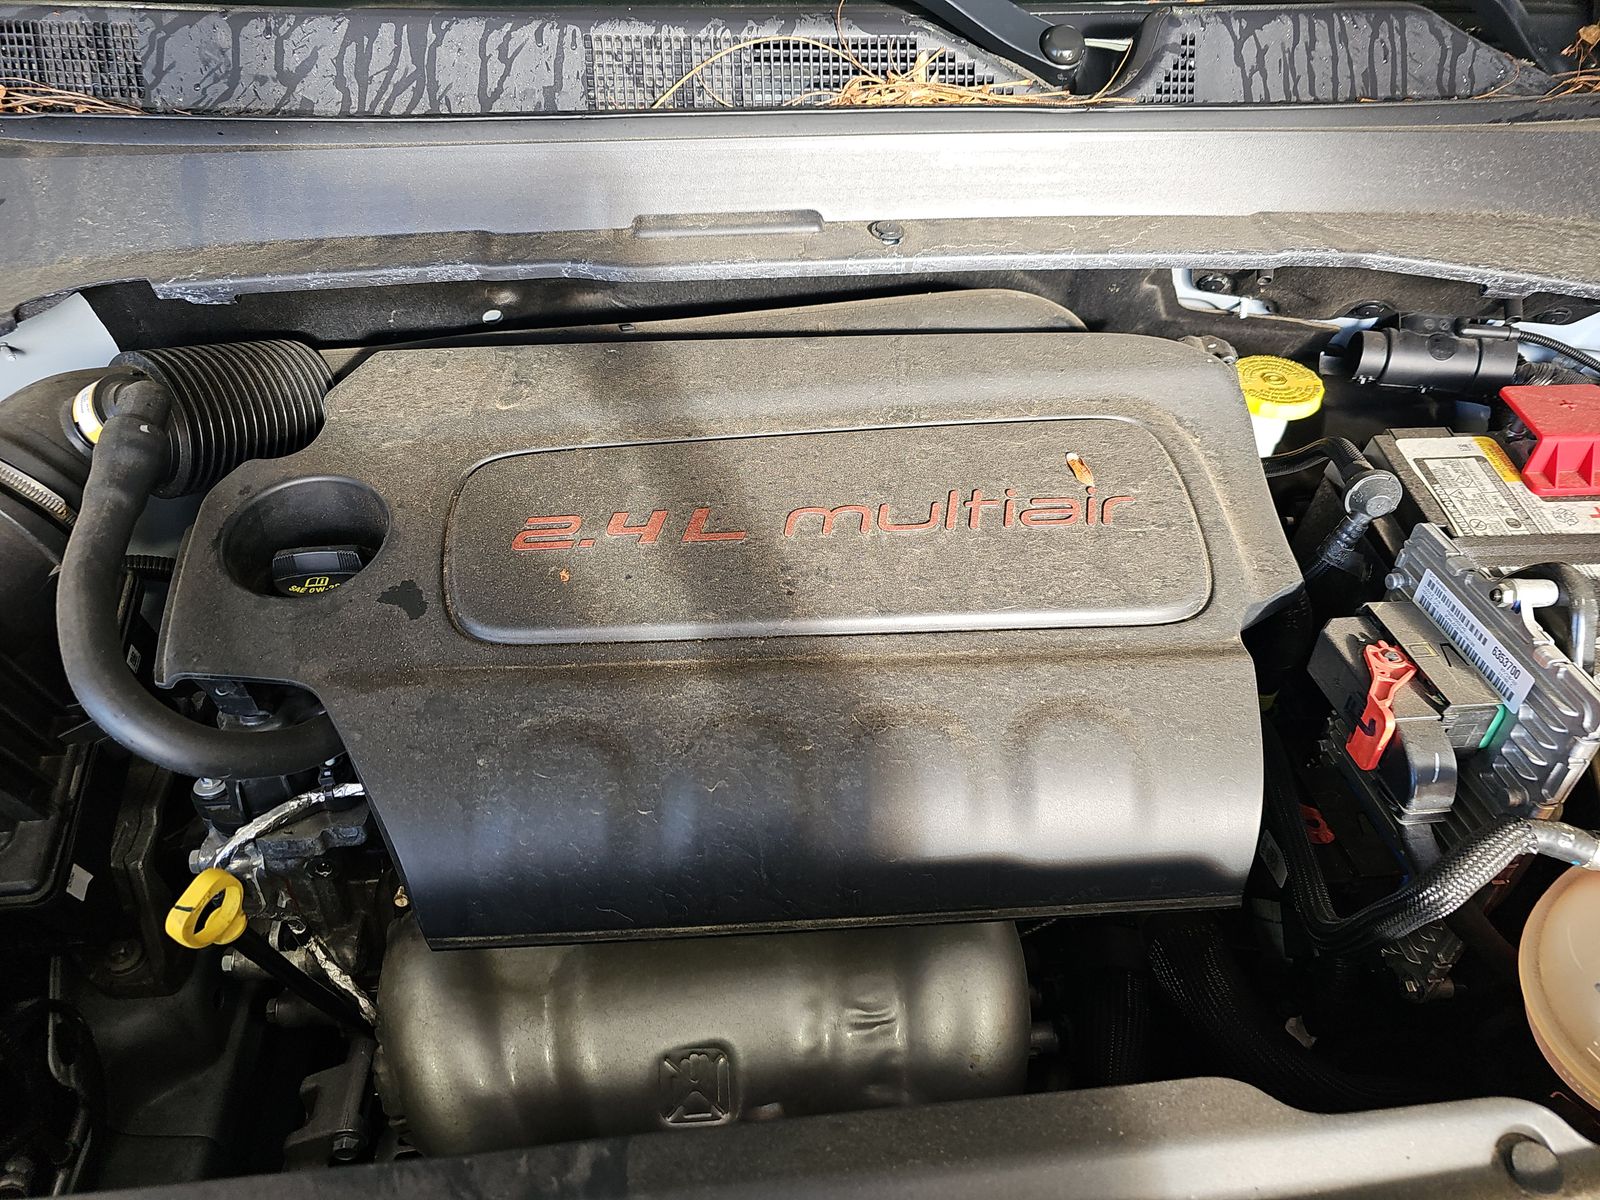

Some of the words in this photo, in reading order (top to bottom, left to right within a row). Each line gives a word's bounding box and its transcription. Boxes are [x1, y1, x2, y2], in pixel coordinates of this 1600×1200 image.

[784, 486, 1136, 537] multiair
[1431, 483, 1458, 512] POISON
[288, 584, 308, 594] SAE
[1490, 645, 1521, 680] 6353700
